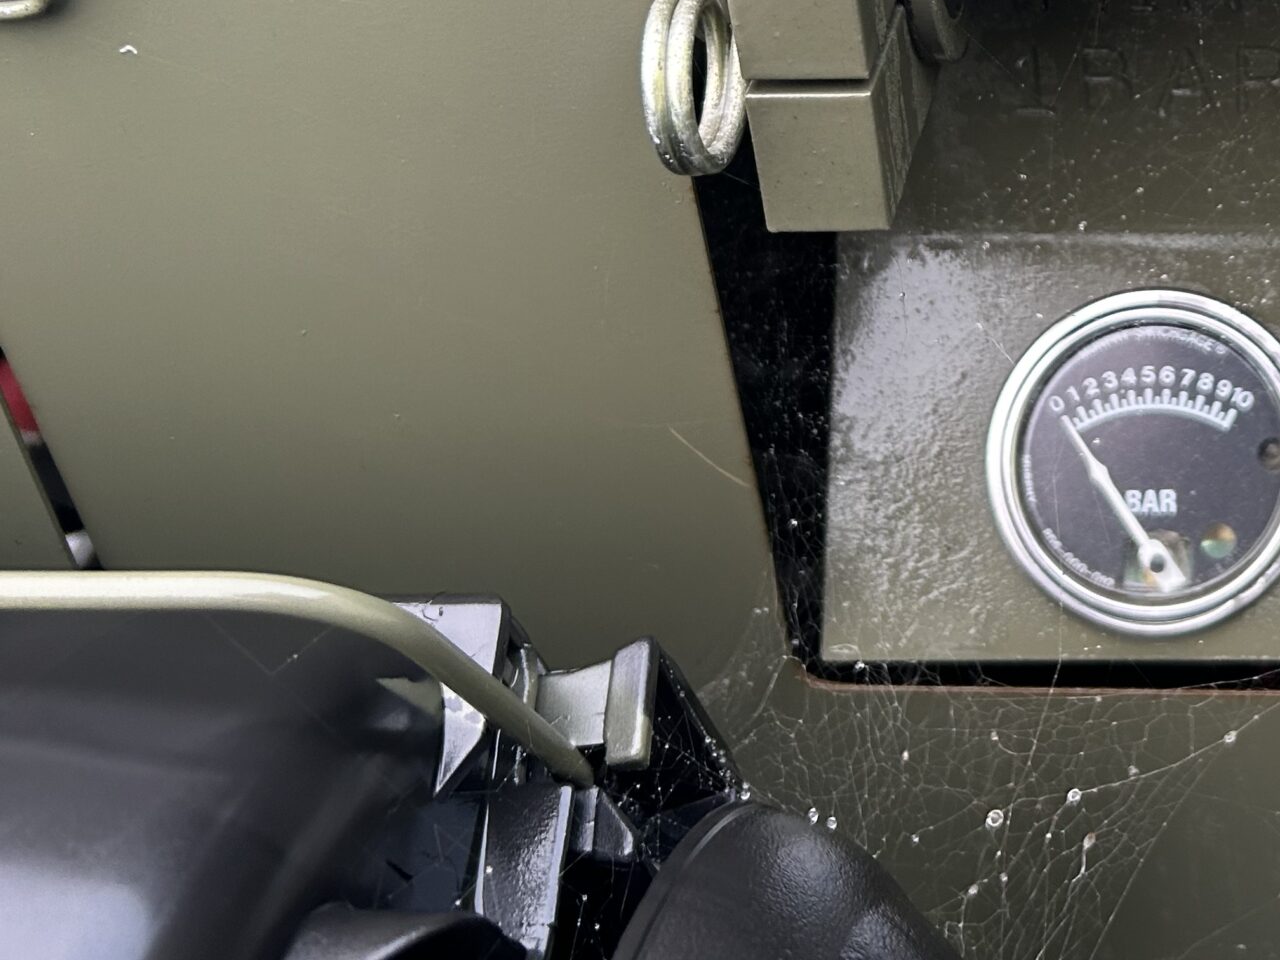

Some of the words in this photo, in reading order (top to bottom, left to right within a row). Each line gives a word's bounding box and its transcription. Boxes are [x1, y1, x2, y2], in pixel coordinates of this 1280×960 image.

[1050, 395, 1065, 413] 0
[1067, 385, 1080, 404] 1
[1083, 377, 1100, 398] 2
[1102, 370, 1118, 390] 3
[1120, 367, 1138, 387] 4
[1141, 365, 1156, 386] 5
[1159, 365, 1175, 387] 6
[1180, 368, 1196, 388] 7
[1197, 372, 1214, 392] 8
[1215, 379, 1233, 399] 9
[1230, 386, 1255, 409] 10
[1123, 488, 1178, 517] BAR
